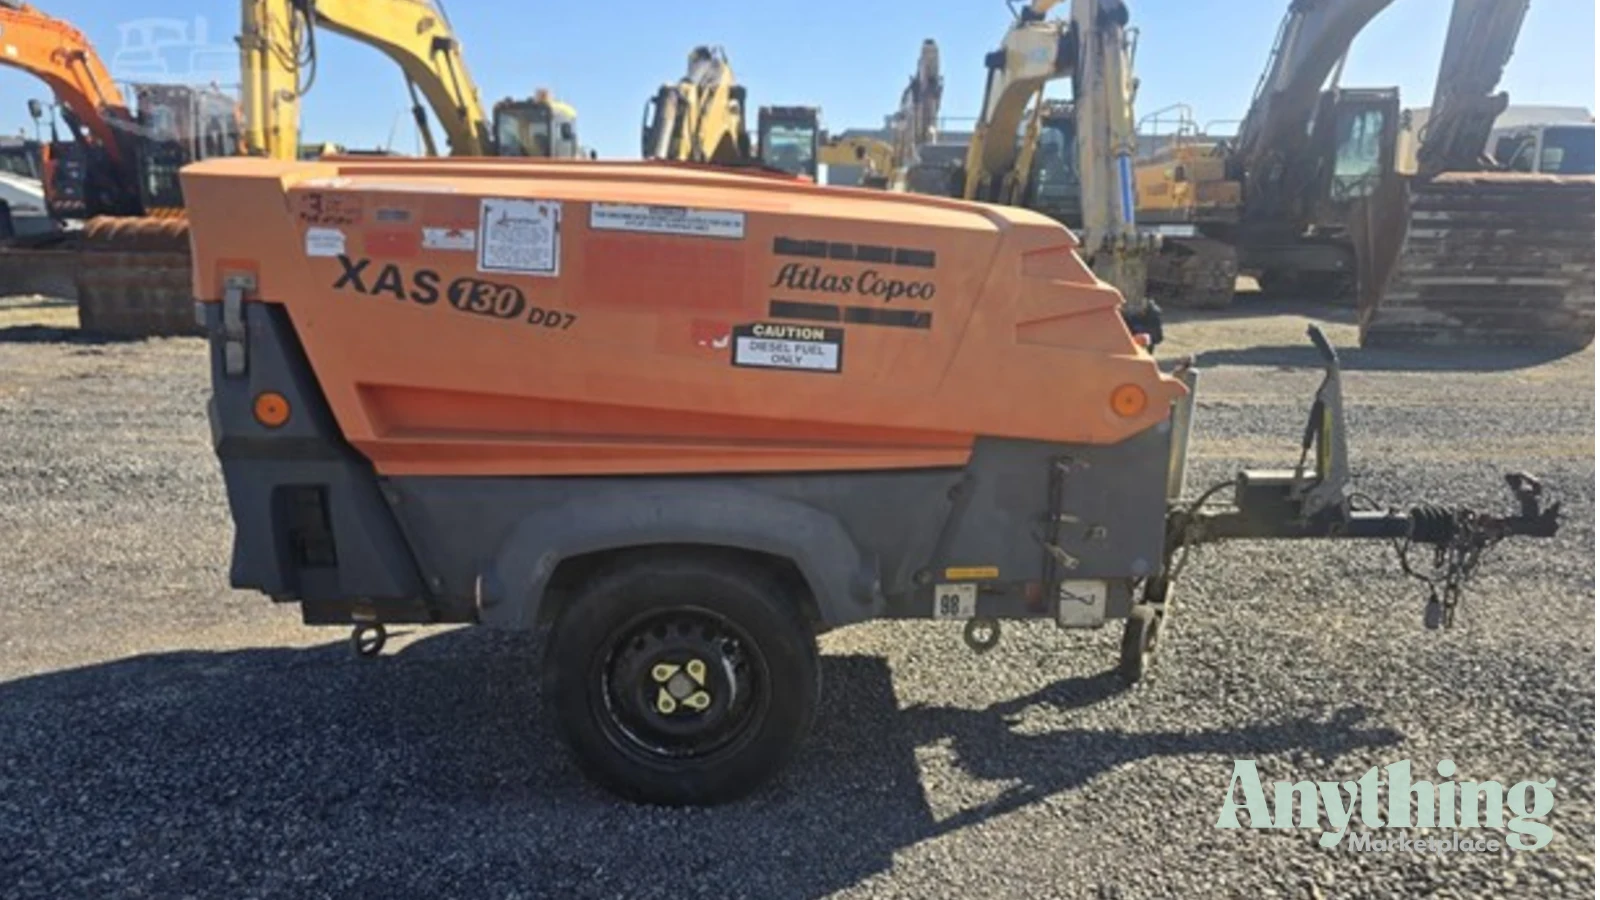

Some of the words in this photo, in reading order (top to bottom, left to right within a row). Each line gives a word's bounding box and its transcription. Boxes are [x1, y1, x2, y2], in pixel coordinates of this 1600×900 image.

[770, 263, 855, 293] Atlas
[856, 270, 937, 302] Copco
[332, 254, 441, 305] XAS
[456, 280, 518, 317] 130
[527, 306, 577, 331] DD7
[752, 324, 825, 341] CAUTION
[749, 341, 792, 354] DIESEL
[794, 344, 825, 356] FUEL
[770, 353, 803, 365] ONLY
